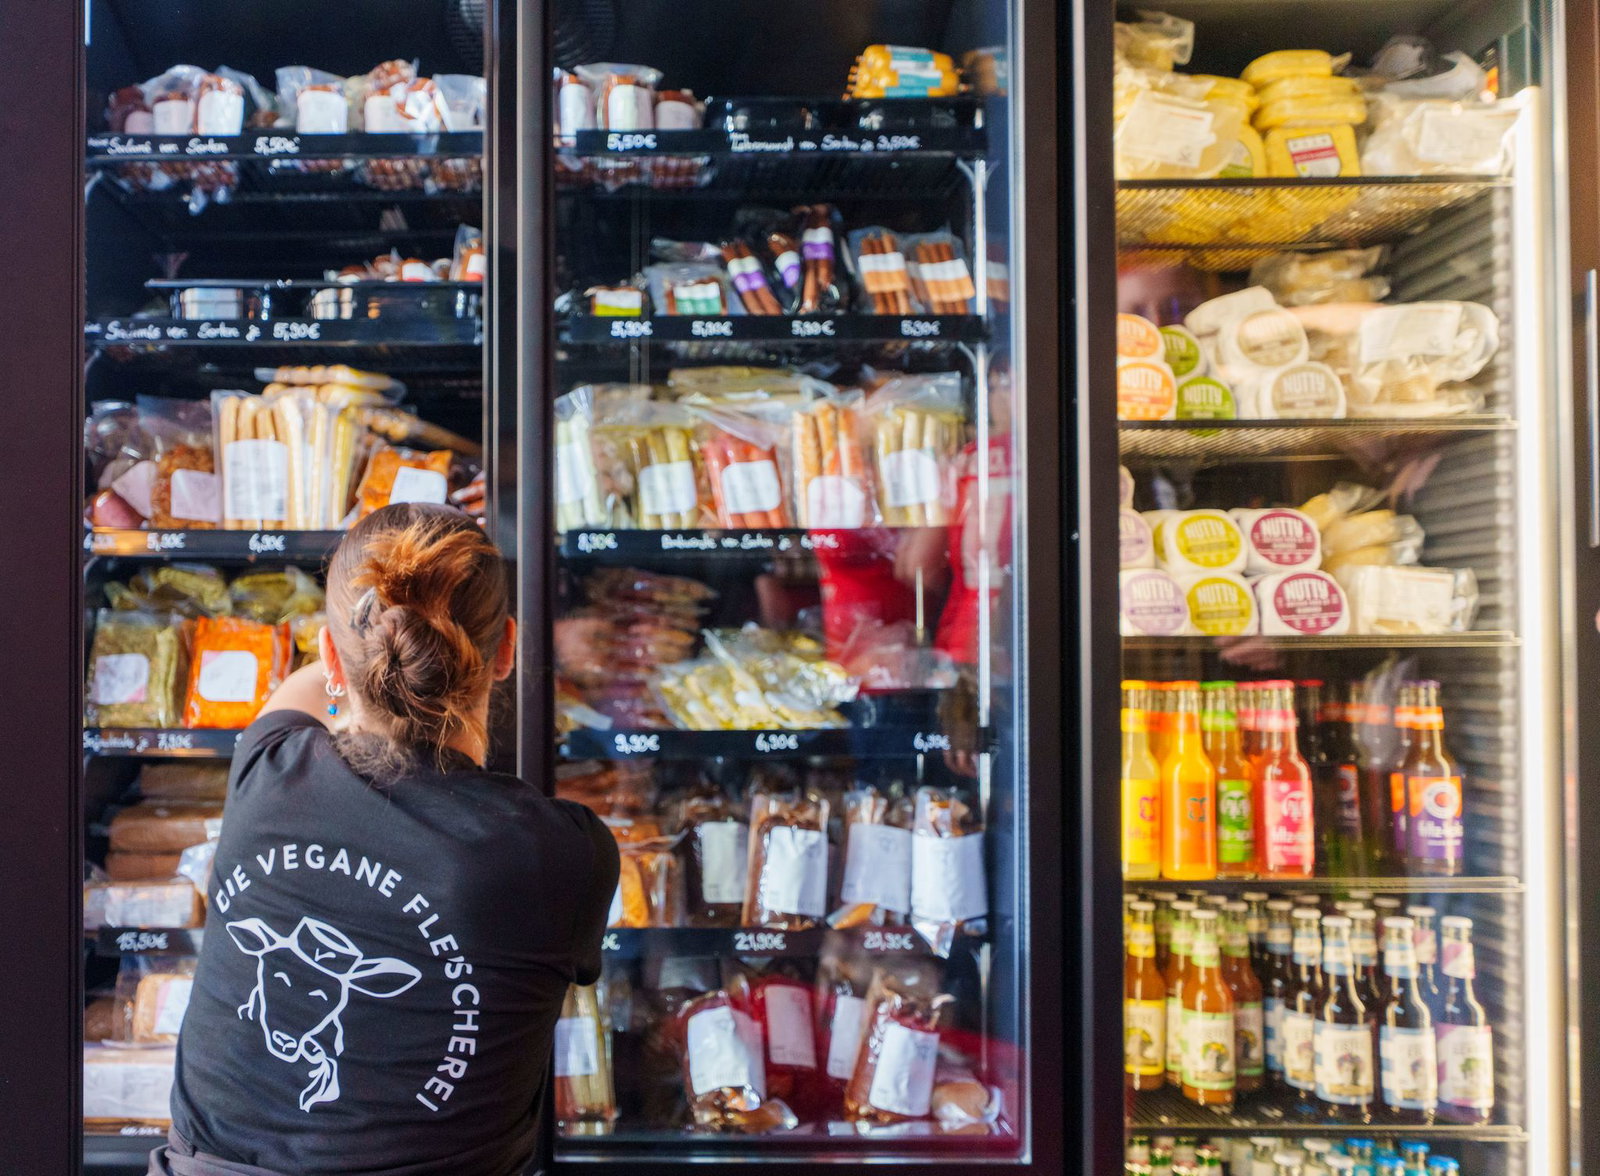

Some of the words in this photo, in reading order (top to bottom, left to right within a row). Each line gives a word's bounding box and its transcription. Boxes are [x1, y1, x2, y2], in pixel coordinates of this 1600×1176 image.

[1183, 383, 1223, 405] NUTTY
[1283, 372, 1326, 394] NUTTY
[1184, 518, 1226, 540] NUTTY
[1260, 516, 1304, 538] NUTTY
[1131, 578, 1174, 601] NUTTY
[1195, 582, 1239, 604] NUTTY
[1283, 577, 1329, 601] NUTTY
[215, 864, 252, 914] DIE
[256, 843, 402, 898] VEGANE
